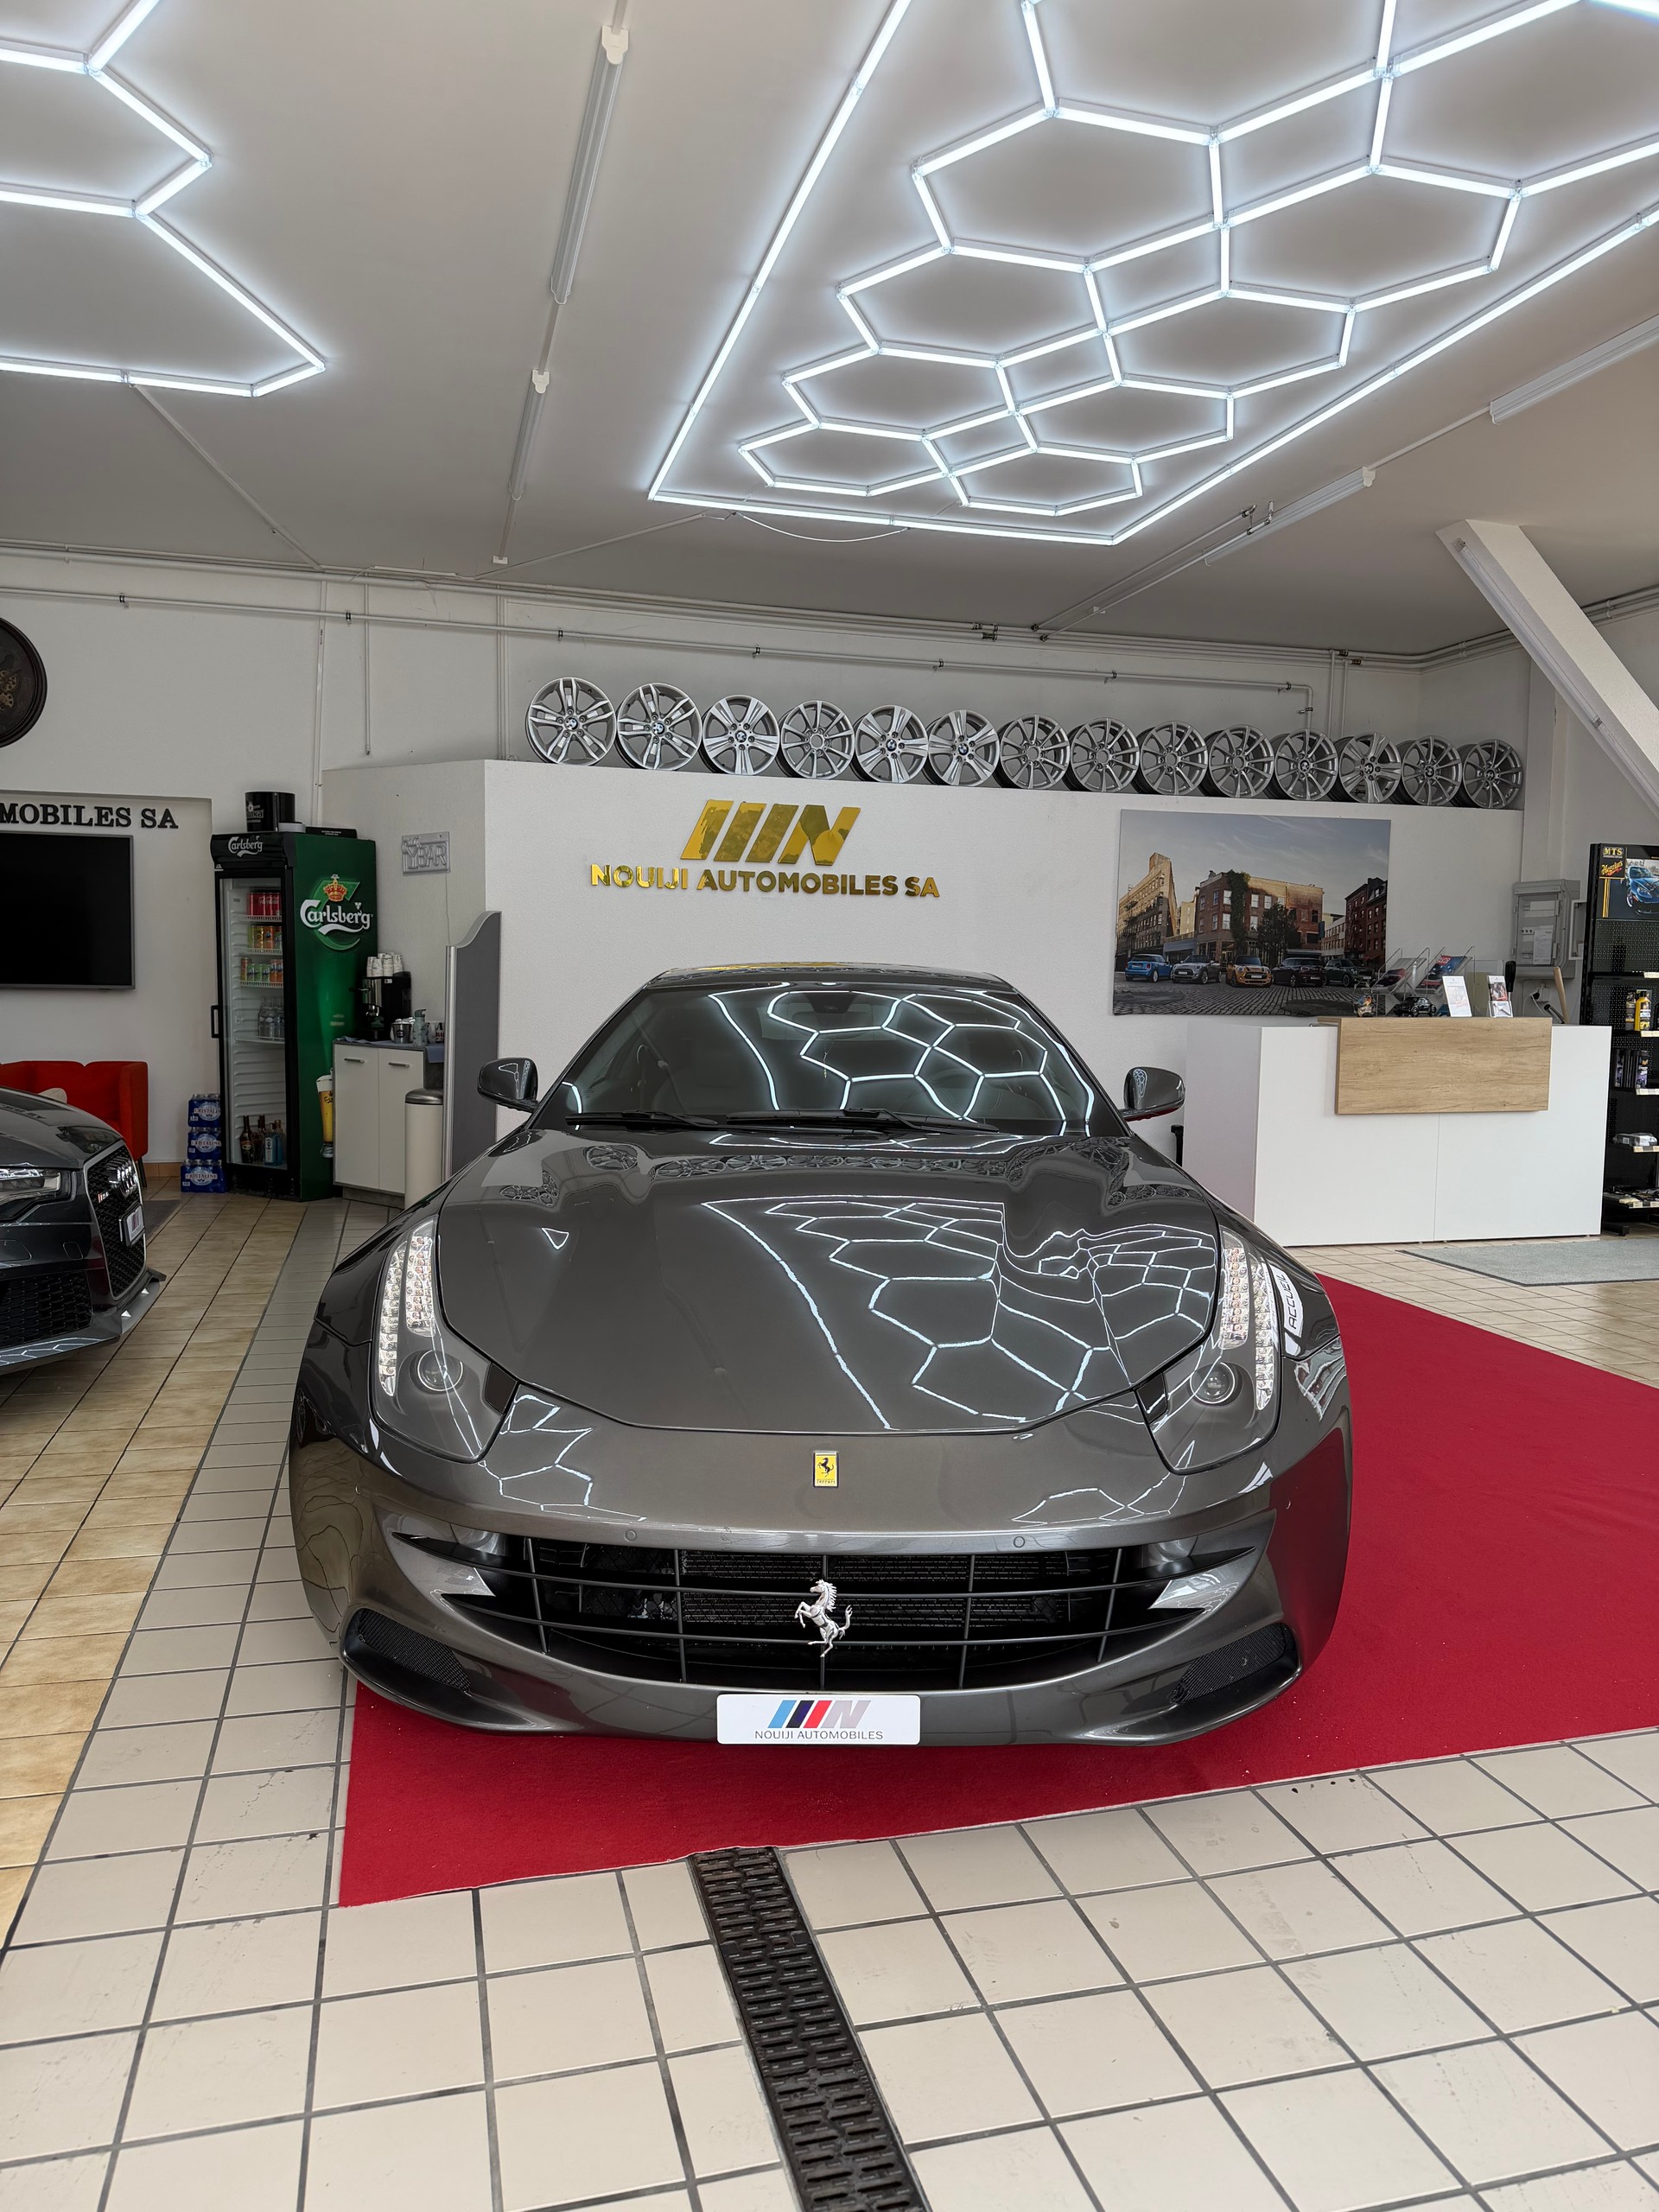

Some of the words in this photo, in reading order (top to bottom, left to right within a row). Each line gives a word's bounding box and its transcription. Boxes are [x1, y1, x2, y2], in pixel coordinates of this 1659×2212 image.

[0, 803, 132, 828] MOBILES
[141, 808, 179, 830] SA
[228, 836, 264, 856] Carlsberg
[591, 864, 689, 891] NOUIJI
[696, 868, 899, 897] AUTOMOBILES
[905, 875, 941, 899] SA
[300, 899, 372, 934] Carlsberg
[1276, 1274, 1298, 1330] ACCUEIL
[754, 1730, 794, 1740] NOUIJI
[797, 1730, 884, 1740] AUTOMOBILES
